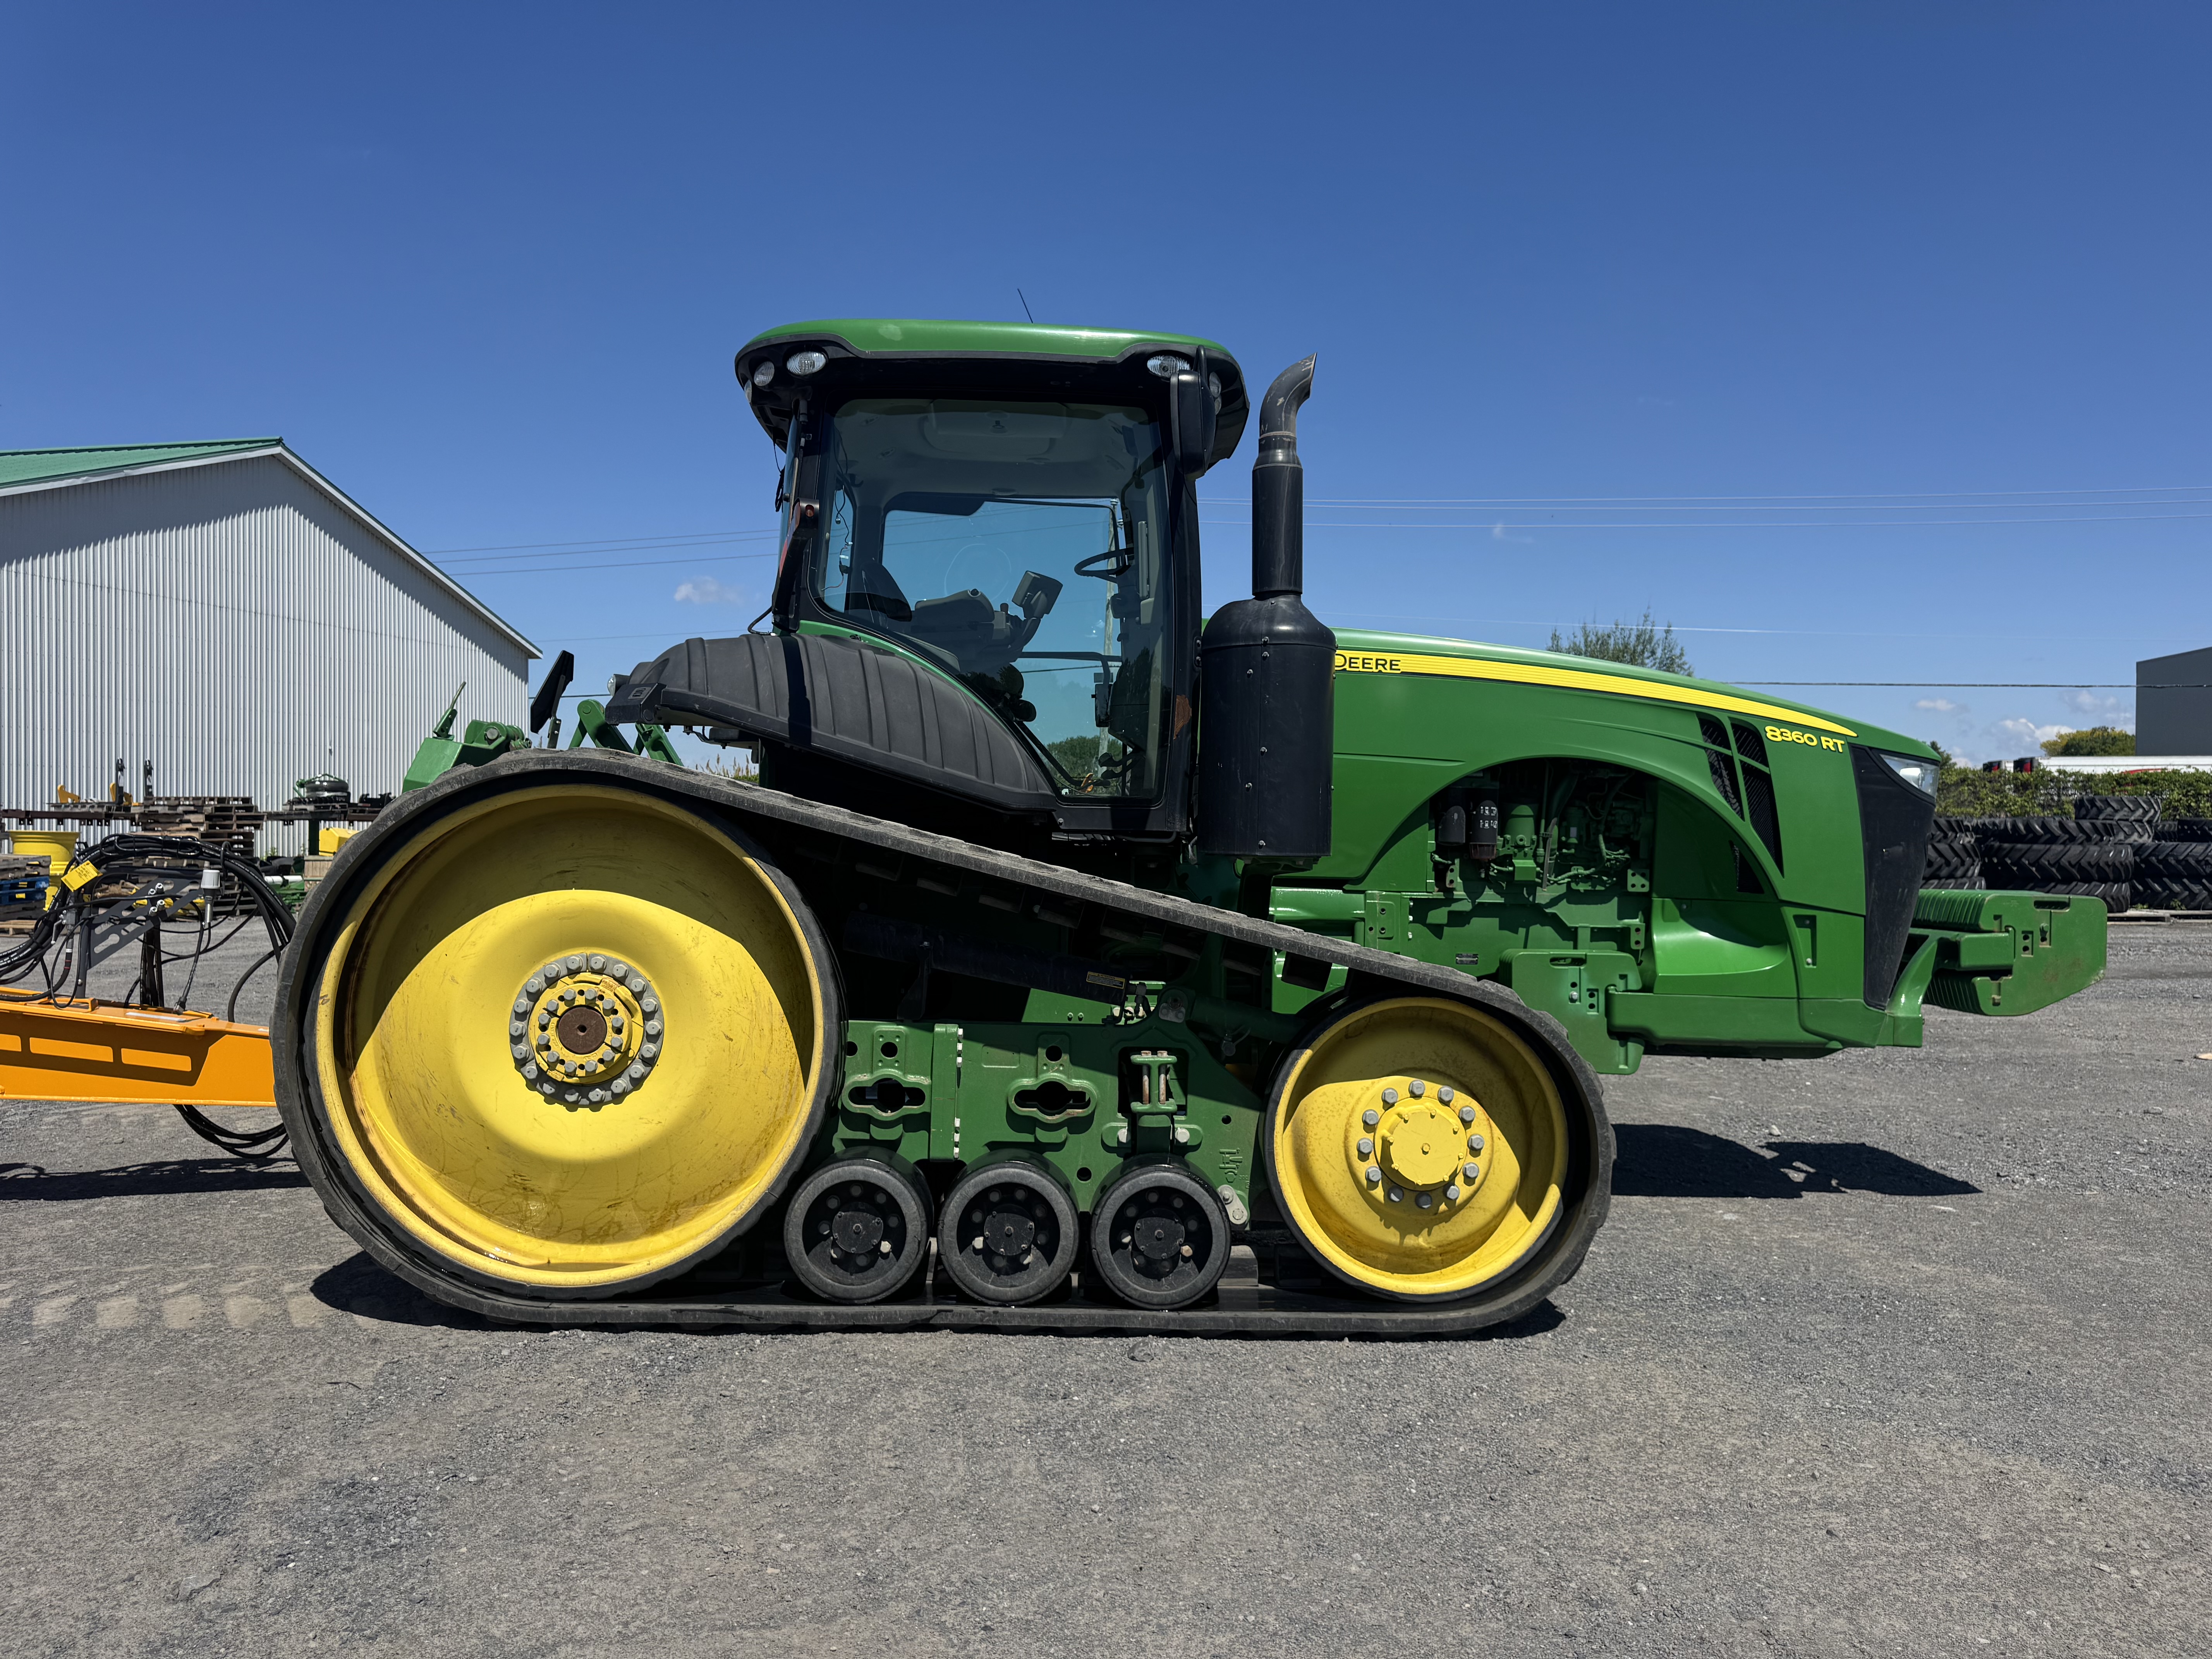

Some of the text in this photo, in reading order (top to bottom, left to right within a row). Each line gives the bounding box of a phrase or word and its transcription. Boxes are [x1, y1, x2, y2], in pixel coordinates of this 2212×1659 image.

[1335, 653, 1401, 671] DEERE
[1765, 726, 1845, 752] 8360 RT
